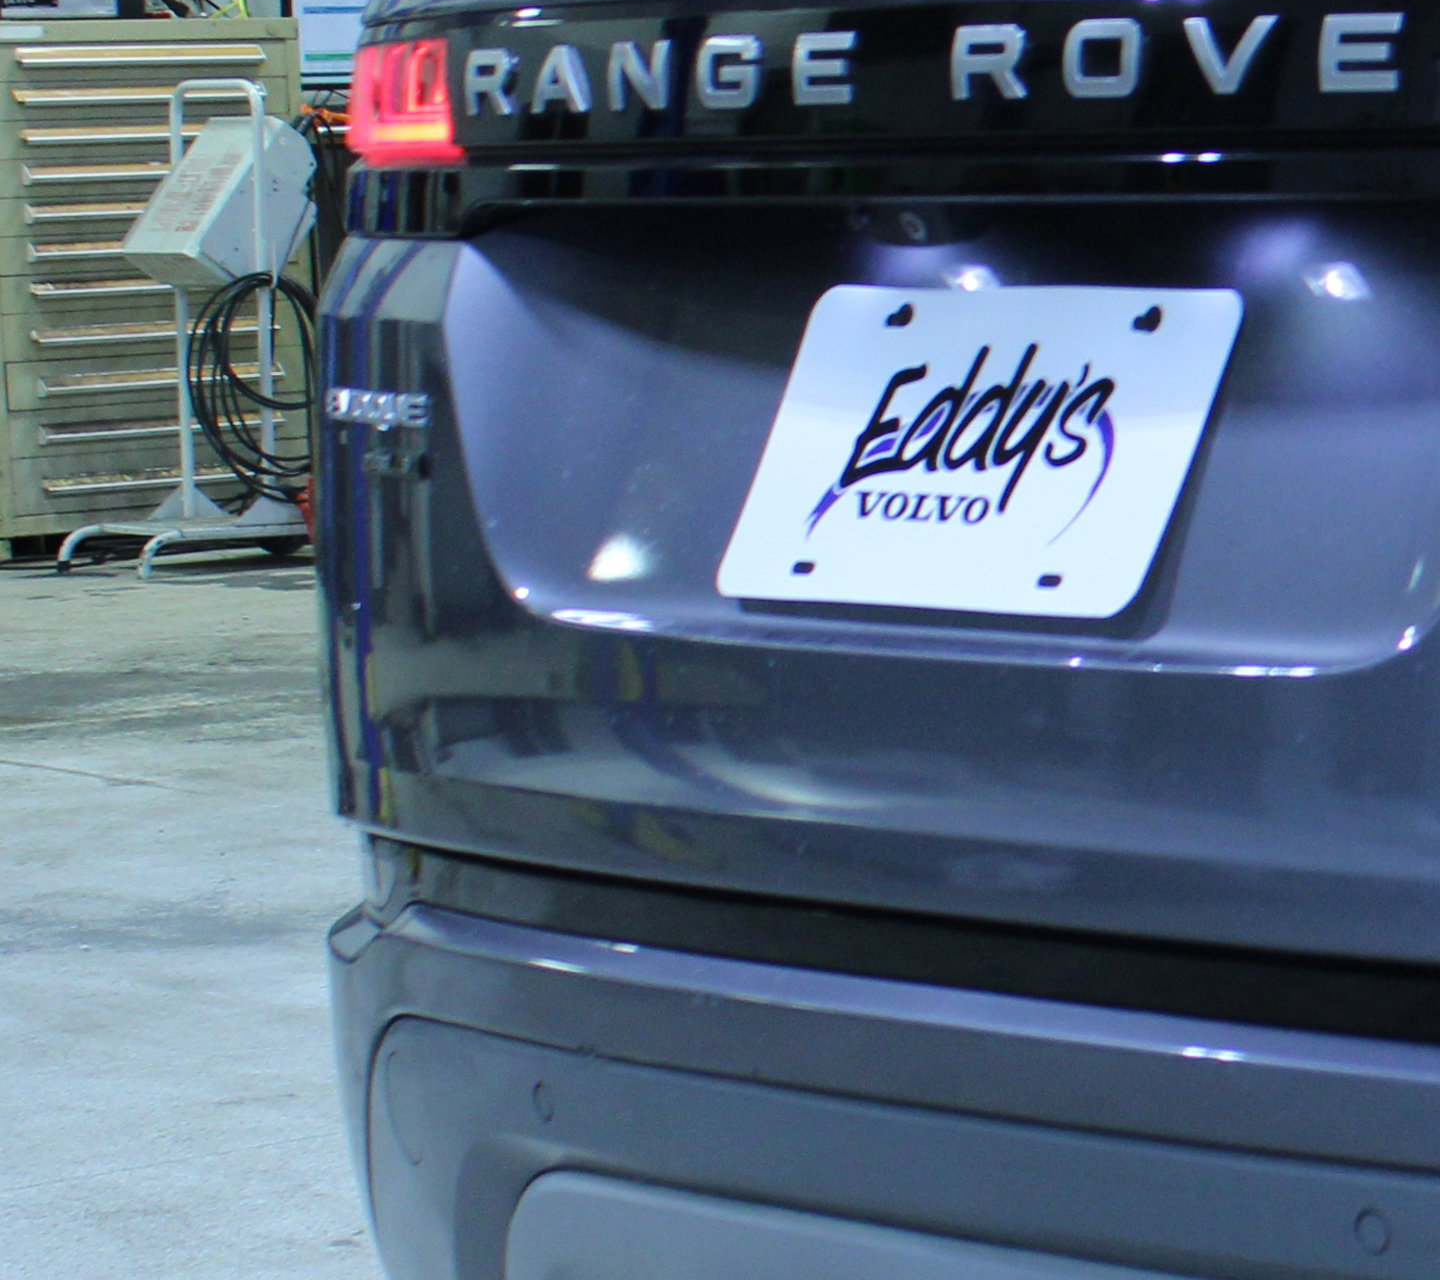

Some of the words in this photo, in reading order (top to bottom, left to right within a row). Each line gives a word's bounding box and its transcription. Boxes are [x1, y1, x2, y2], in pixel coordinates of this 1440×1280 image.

[462, 29, 858, 117] RANGE
[839, 342, 1115, 516] Eddy's
[855, 490, 991, 524] VOLVO
